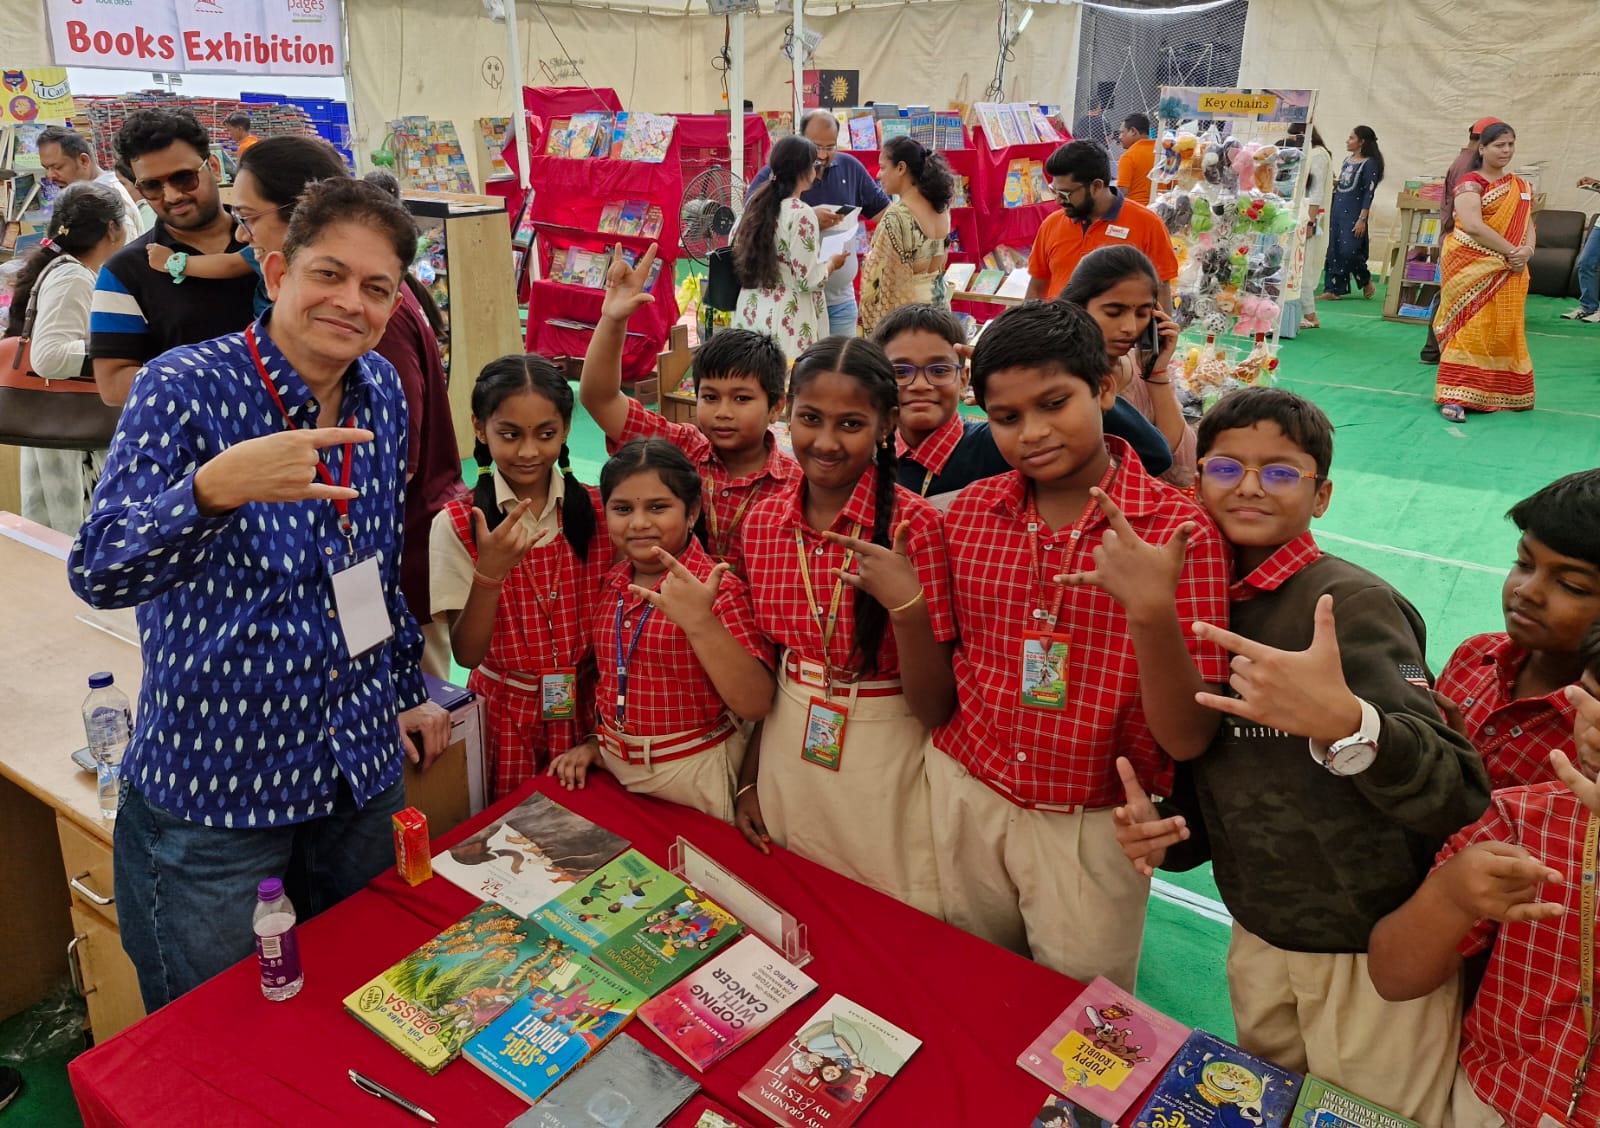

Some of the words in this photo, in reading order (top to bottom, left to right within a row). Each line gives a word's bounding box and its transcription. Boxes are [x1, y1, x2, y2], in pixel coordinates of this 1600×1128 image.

[66, 20, 174, 60] Books
[183, 30, 334, 65] Exhibition
[1205, 97, 1227, 111] Key
[1229, 98, 1269, 109] chains
[619, 946, 656, 975] CALLED
[751, 971, 786, 999] STRATEGIES
[773, 969, 786, 980] BIG
[785, 978, 799, 990] THE
[711, 967, 769, 1015] CANCER
[375, 1005, 388, 1014] of
[384, 992, 440, 1038] ORISSA
[673, 997, 695, 1015] KUMAR
[688, 983, 746, 1031] COPING
[717, 990, 757, 1023] WITH
[387, 1011, 407, 1030] Tales
[694, 1014, 727, 1041] RAMENDRA
[407, 1027, 424, 1042] Folk
[511, 1014, 570, 1056] CRICKET
[499, 1037, 541, 1067] SIEGE
[1071, 1051, 1106, 1077] PUPPY
[1077, 1041, 1117, 1069] TROUBLE
[812, 1103, 831, 1119] my
[1322, 1090, 1377, 1119] RANGARAJAN
[804, 1116, 824, 1128] my
